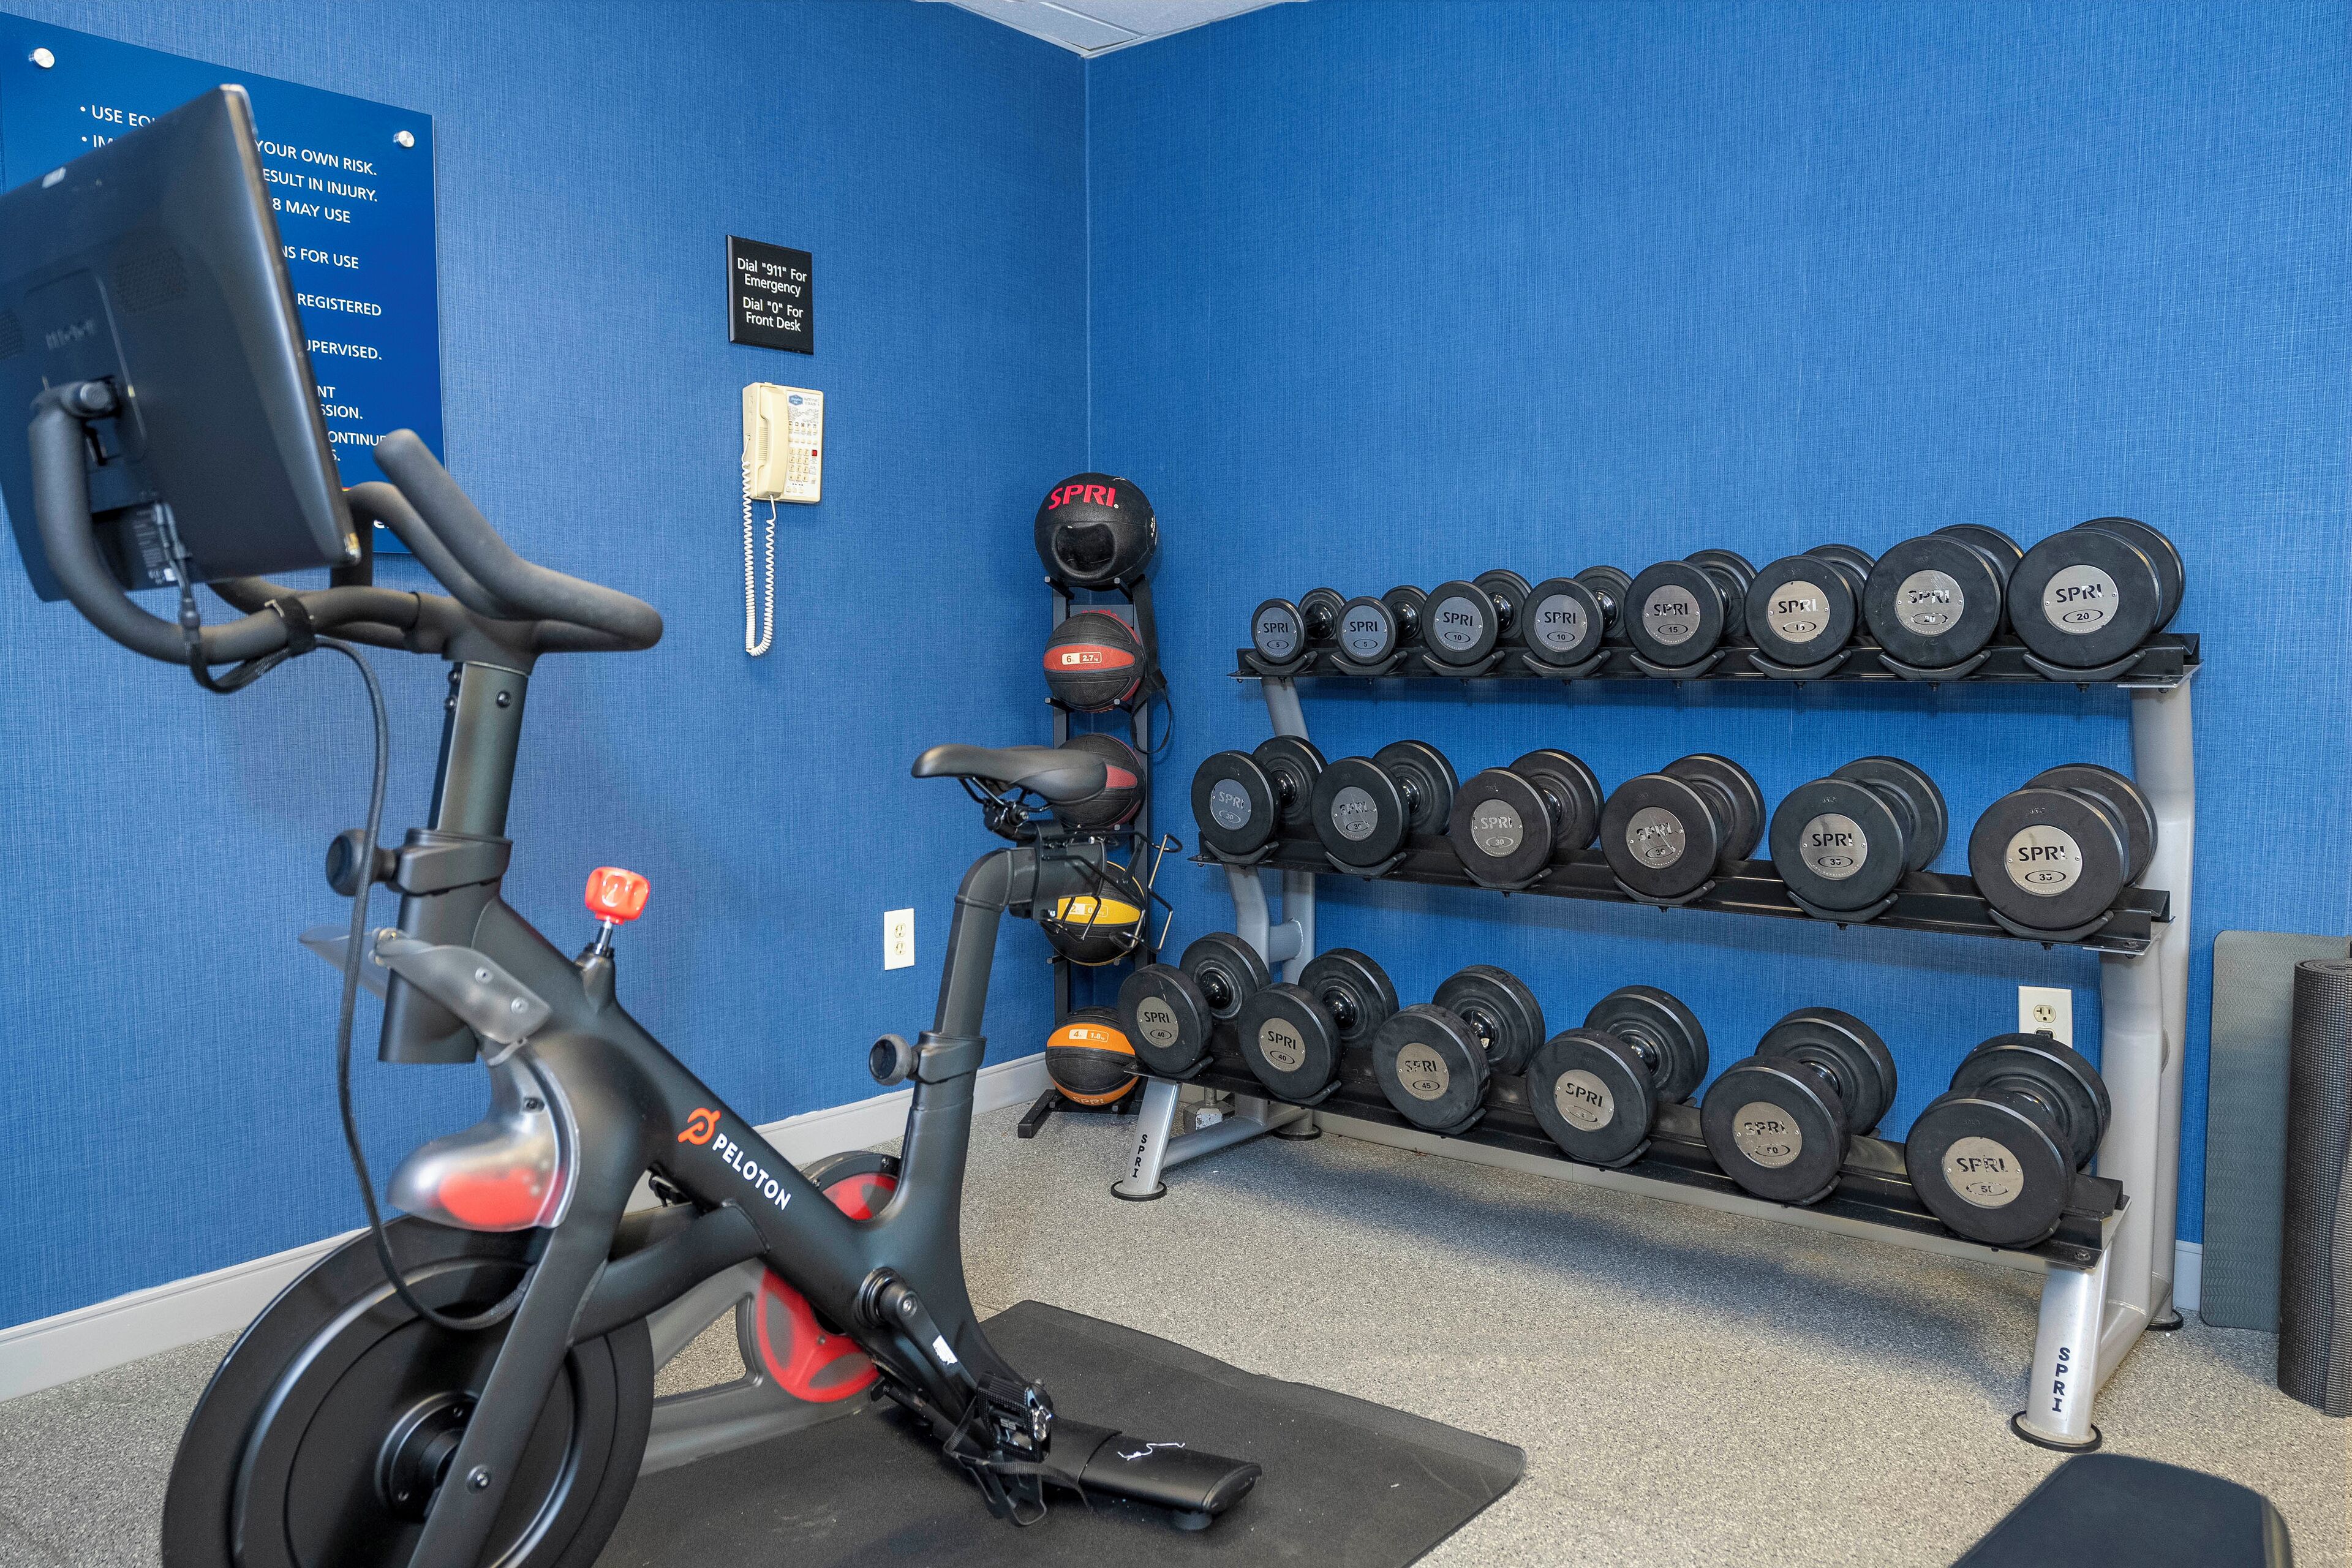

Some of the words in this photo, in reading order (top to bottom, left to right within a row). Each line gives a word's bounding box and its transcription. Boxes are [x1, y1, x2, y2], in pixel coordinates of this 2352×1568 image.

[92, 105, 123, 124] USE
[254, 139, 297, 159] YOUR
[301, 149, 338, 168] OWN
[343, 157, 377, 176] RISK.
[263, 168, 304, 187] ESULT
[309, 177, 323, 192] IN
[328, 181, 377, 202] INJURY.
[286, 200, 320, 217] MAY
[325, 207, 350, 223] USE
[301, 248, 329, 264] FOR
[333, 253, 359, 269] USE
[737, 257, 758, 273] Dial
[762, 262, 786, 277] "911"
[791, 268, 807, 282] For
[744, 273, 801, 297] Emergency
[297, 293, 382, 316] REGISTERED
[743, 296, 763, 311] Dial
[767, 301, 783, 314] "0"
[787, 305, 804, 318] For
[746, 311, 774, 327] Front
[777, 317, 801, 331] Desk
[1048, 484, 1117, 510] SPRI
[2056, 584, 2103, 603] SPRI
[1654, 603, 1689, 616] SPRI
[1778, 598, 1816, 614] SPRI
[1264, 622, 1289, 633] SPRI
[1350, 621, 1378, 632] SPRI
[1443, 612, 1473, 627] SPRI
[1544, 611, 1577, 624] SPRI
[1218, 791, 1245, 810] SPRI
[1480, 816, 1513, 829] SPRI
[1812, 833, 1853, 846] SPRI
[2018, 845, 2067, 862] SPRI
[1144, 1012, 1171, 1023] SPRI
[1268, 1030, 1297, 1050] SPRI
[1566, 1082, 1604, 1108] SPRI
[1132, 1134, 1148, 1178] SPRI
[712, 1133, 791, 1211] PELOTON
[2052, 1347, 2071, 1412] SPRI
